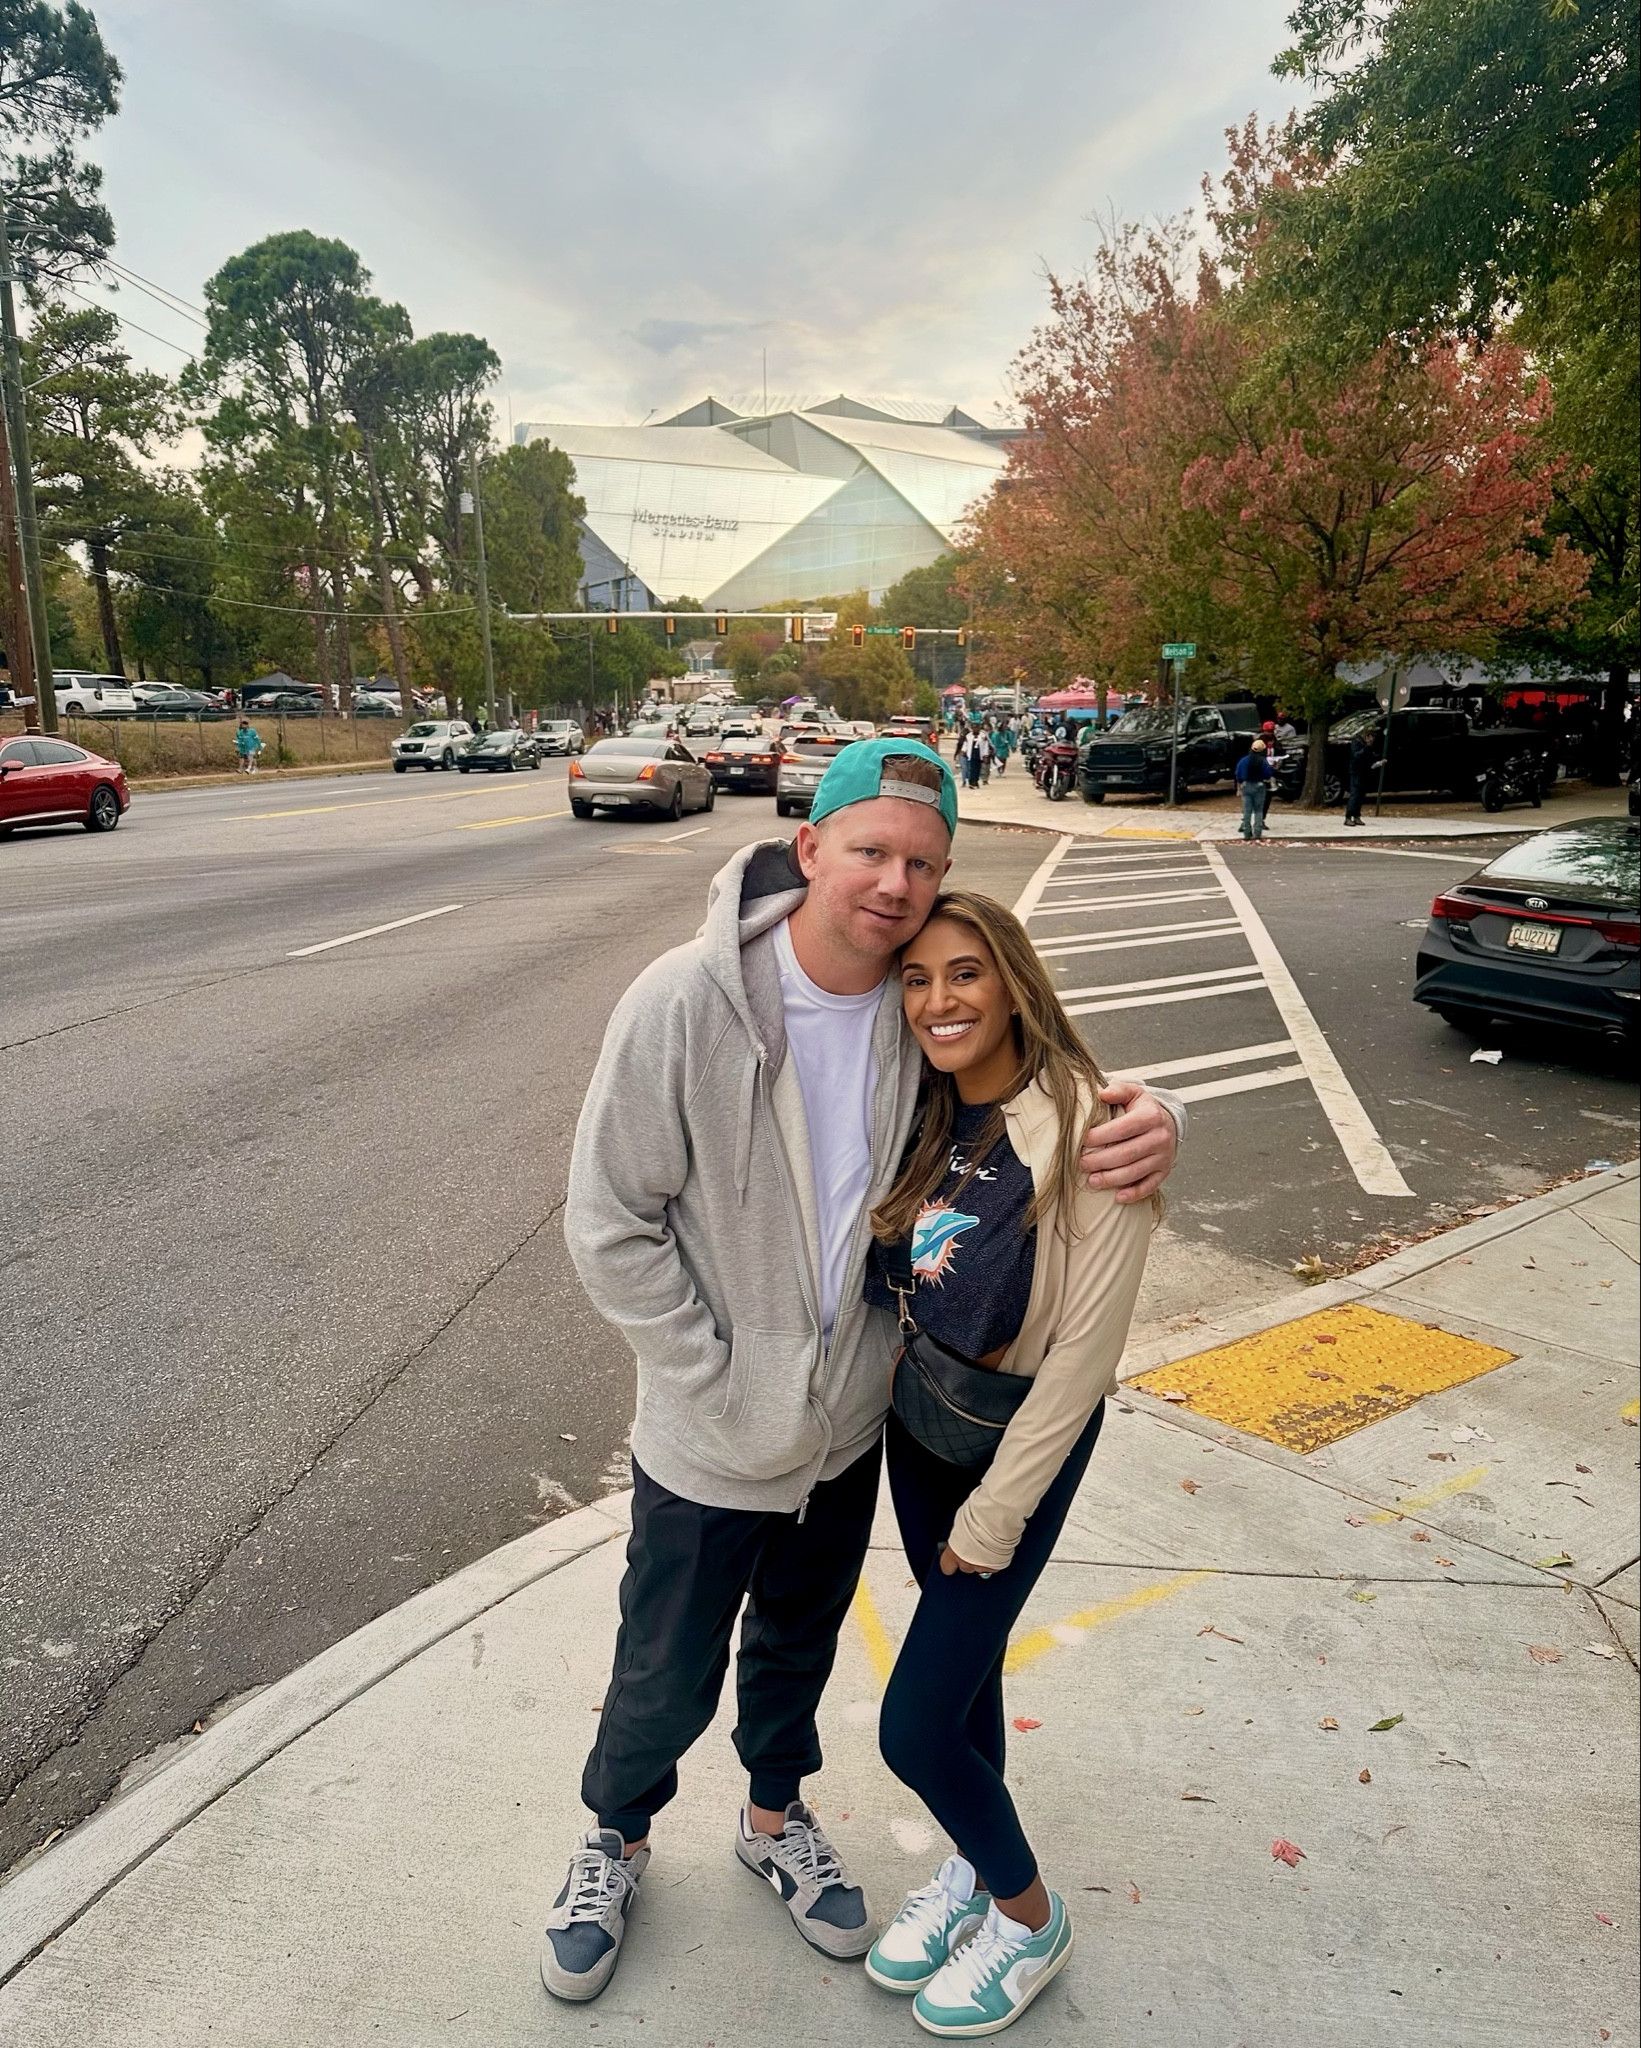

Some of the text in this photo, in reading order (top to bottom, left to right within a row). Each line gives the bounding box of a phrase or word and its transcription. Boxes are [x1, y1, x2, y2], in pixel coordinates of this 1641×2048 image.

[633, 508, 739, 531] Mercedes-Benz
[653, 526, 715, 541] STADIUM
[1513, 927, 1556, 946] CLU2717
